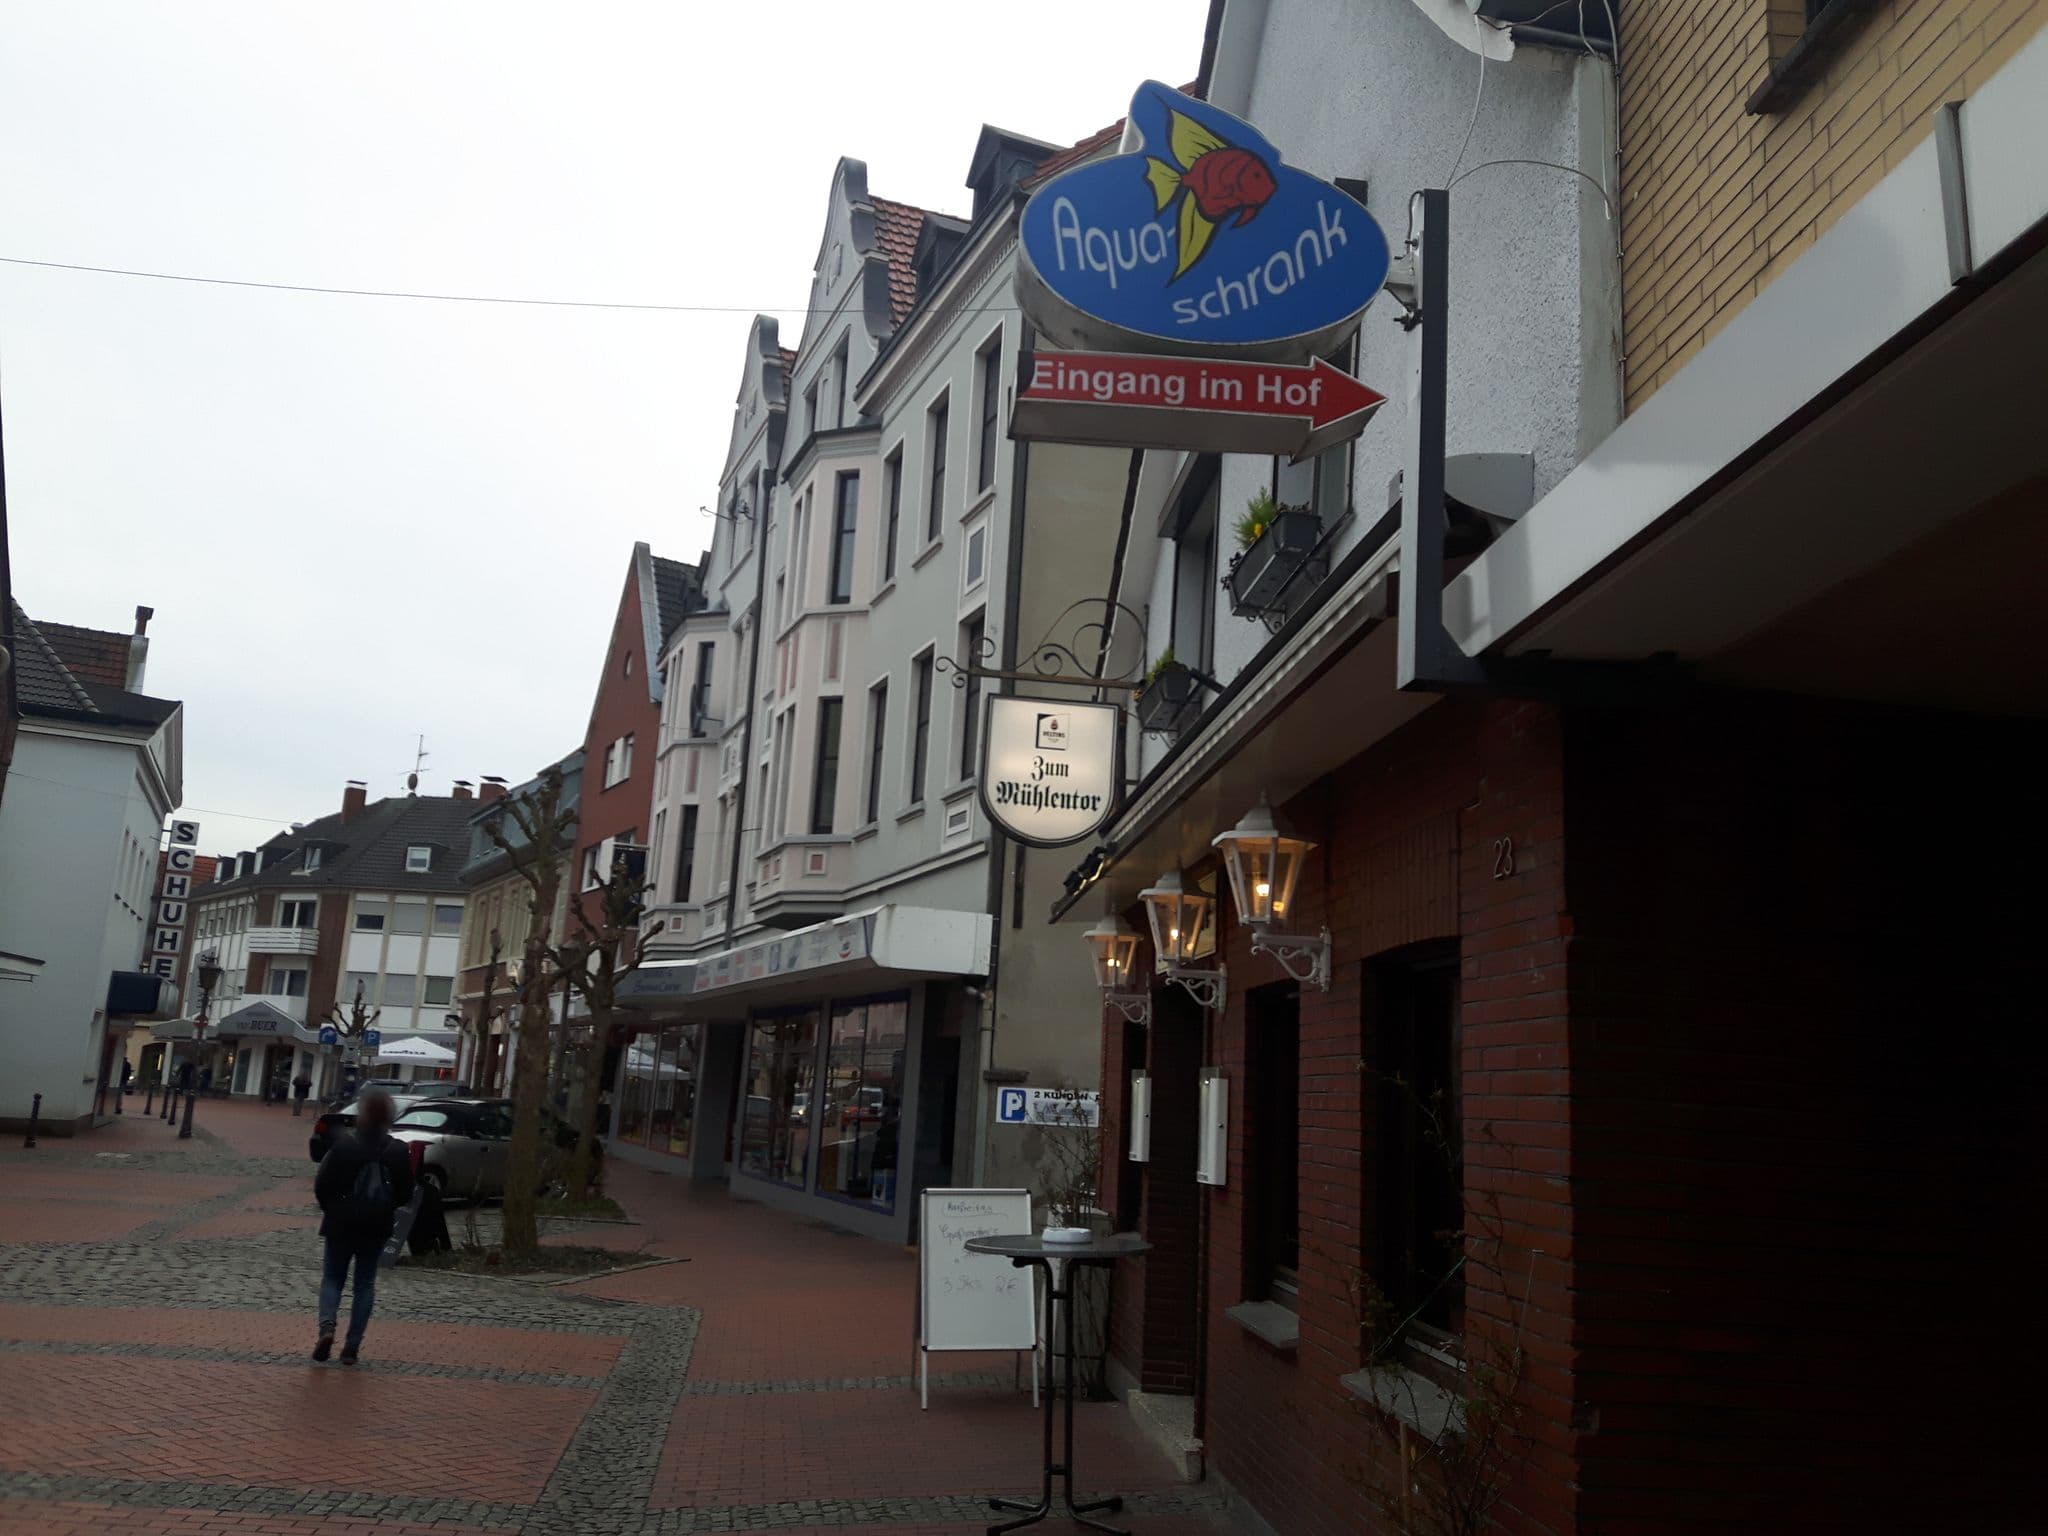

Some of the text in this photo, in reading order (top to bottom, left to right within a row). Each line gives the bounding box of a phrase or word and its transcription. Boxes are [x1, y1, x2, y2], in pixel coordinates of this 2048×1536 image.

[1053, 197, 1176, 289] Aqua-
[1173, 200, 1348, 324] schrank
[1031, 360, 1321, 406] Eingang im Hof
[996, 781, 1101, 814] Mühlentor
[1031, 755, 1069, 782] Zum
[153, 823, 195, 979] SCHUHE
